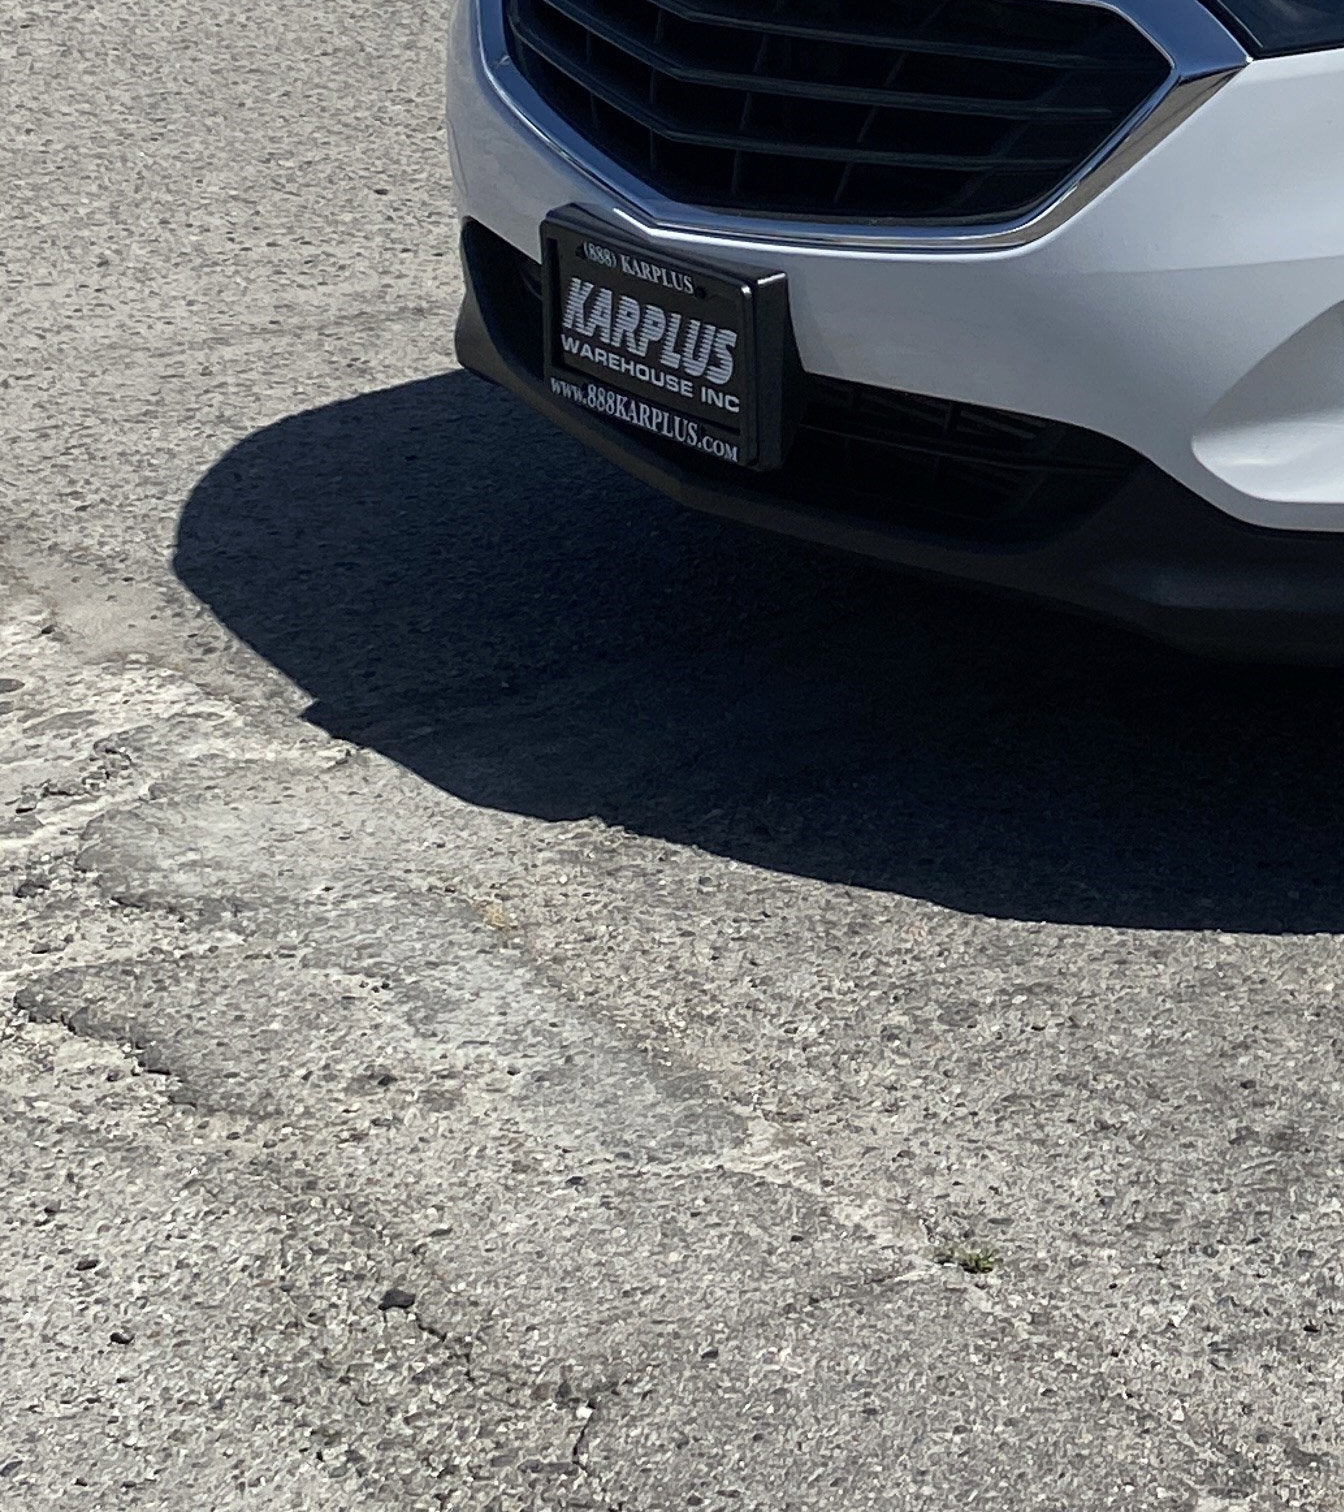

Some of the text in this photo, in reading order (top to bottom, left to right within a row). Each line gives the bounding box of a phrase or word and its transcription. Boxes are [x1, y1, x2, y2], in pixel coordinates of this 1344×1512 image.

[583, 241, 695, 295] (888) KARPLUS
[561, 276, 738, 386] KARPLUS
[560, 334, 740, 414] WAREHOUSE INC
